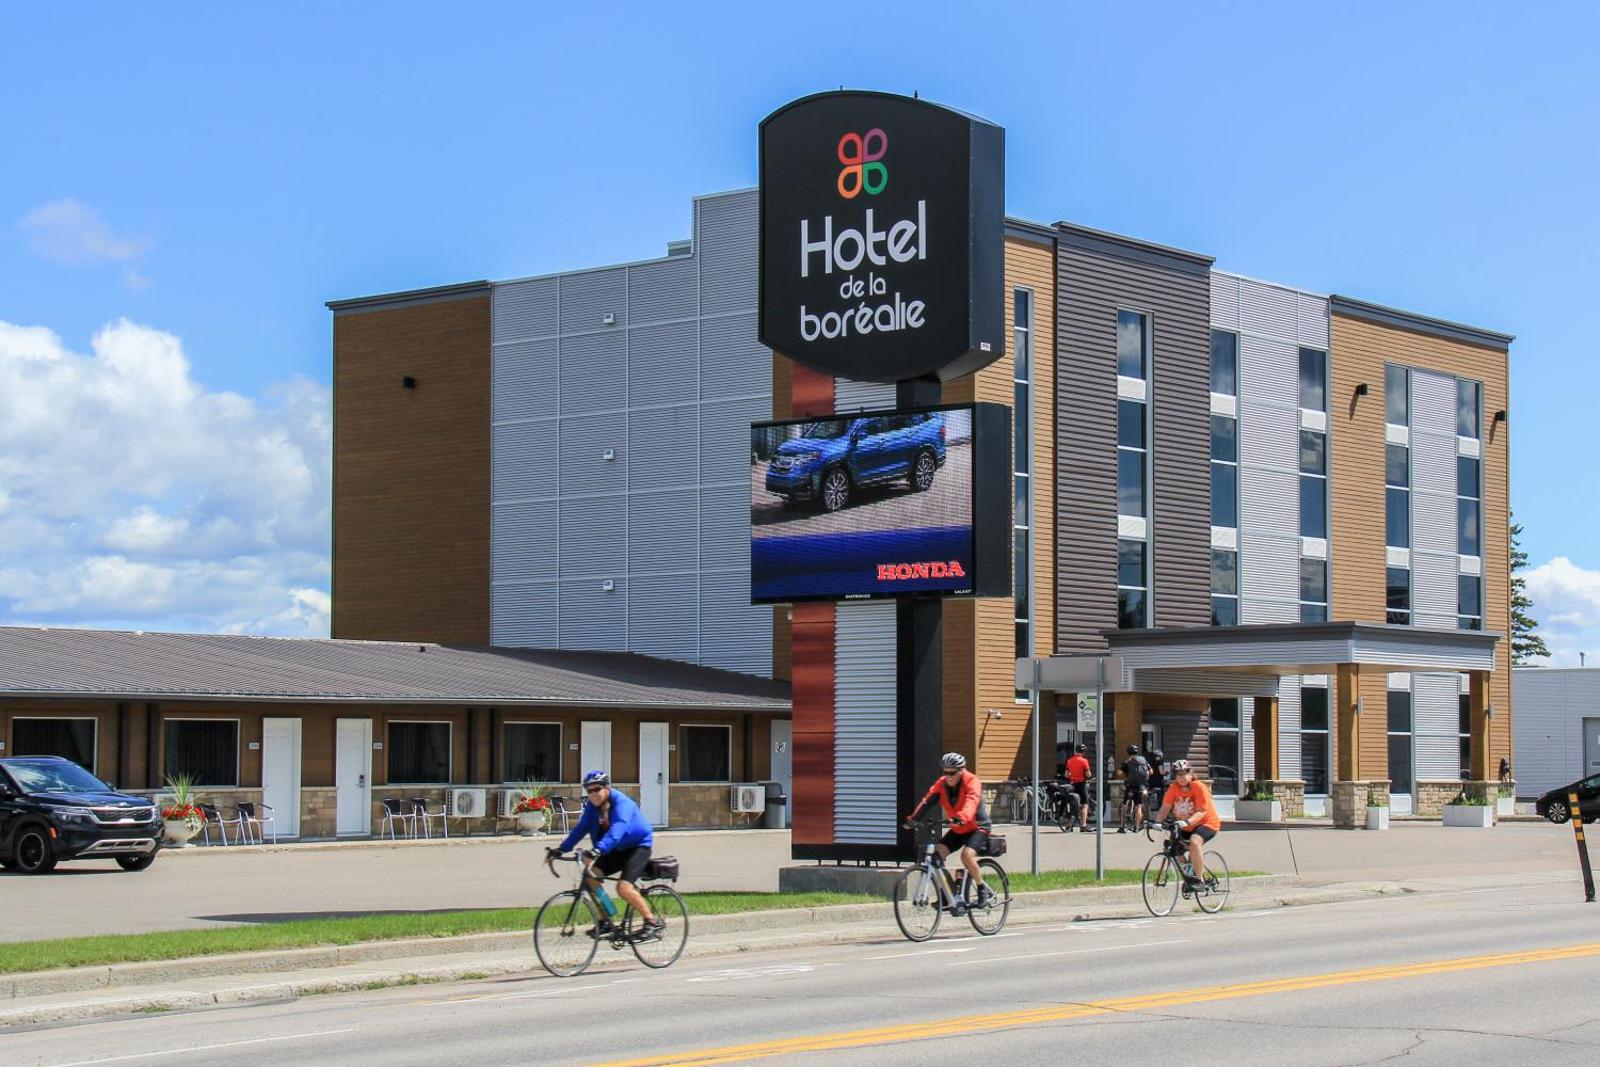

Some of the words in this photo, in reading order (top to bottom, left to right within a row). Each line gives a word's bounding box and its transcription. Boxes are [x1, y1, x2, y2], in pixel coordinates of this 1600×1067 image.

[801, 200, 926, 277] Hotel
[840, 275, 864, 298] de
[869, 272, 886, 295] la
[800, 292, 926, 341] boréalie
[877, 561, 965, 580] HONDA
